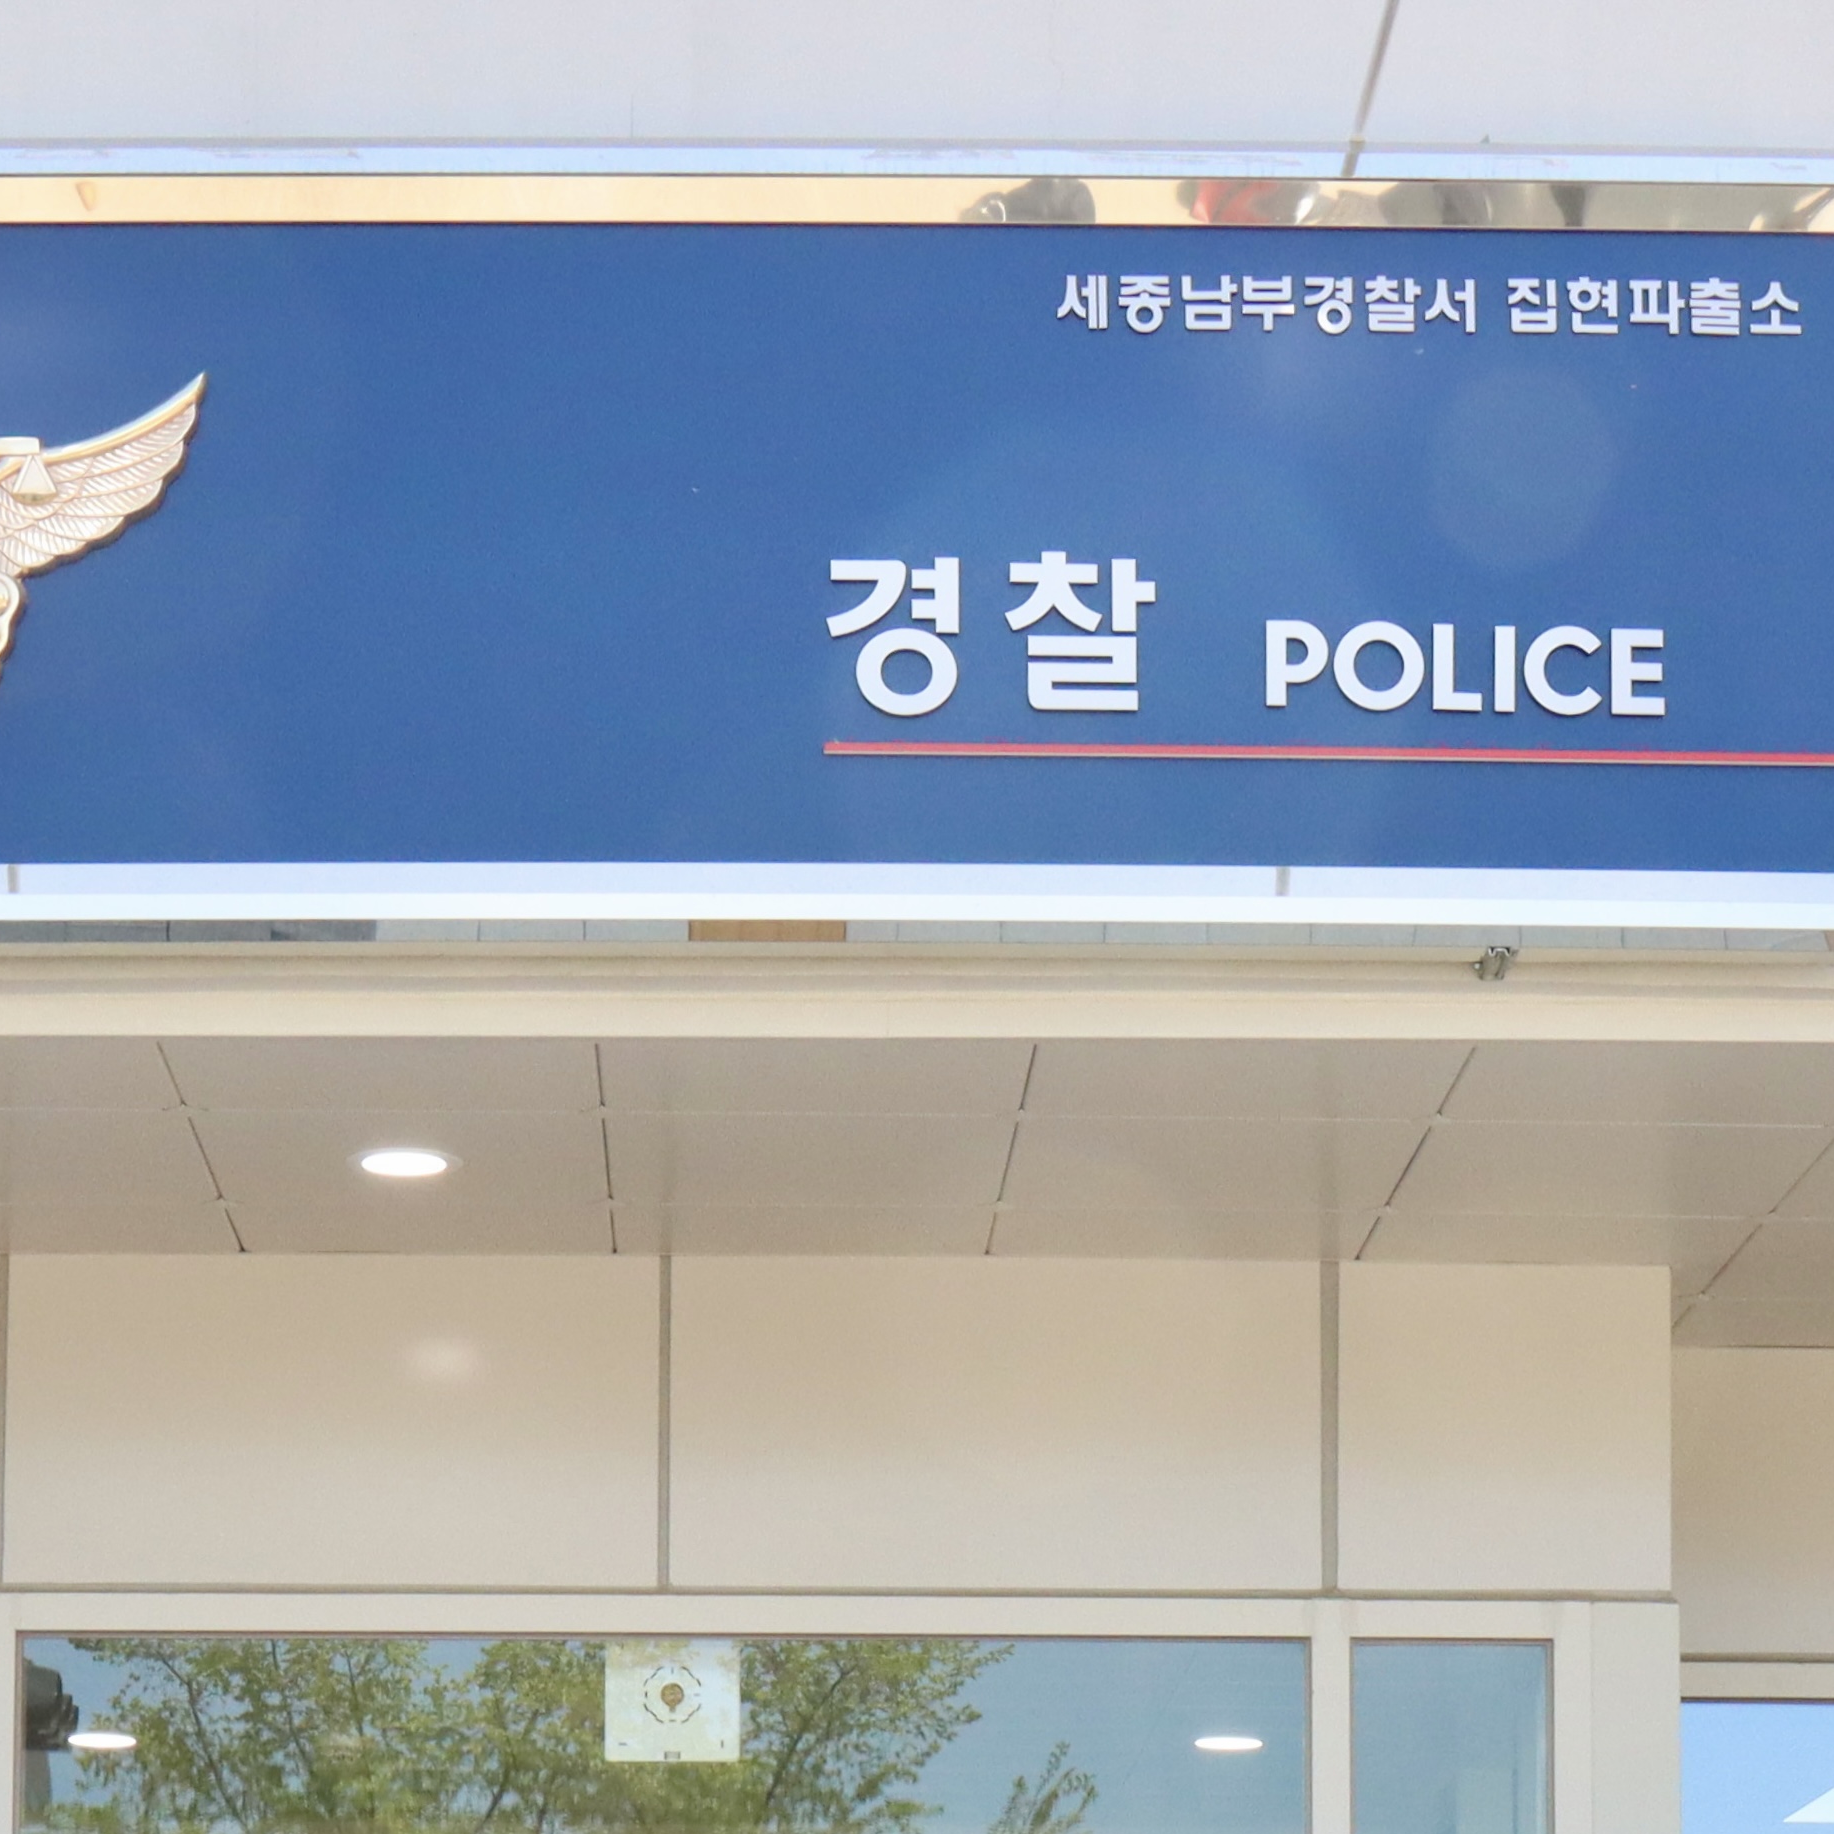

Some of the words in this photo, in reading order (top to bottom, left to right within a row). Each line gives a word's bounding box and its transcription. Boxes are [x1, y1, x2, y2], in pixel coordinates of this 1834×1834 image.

[1057, 274, 1476, 335] 세종남부경찰서
[1507, 277, 1803, 335] 집현파출소
[825, 550, 1156, 716] 경찰
[1264, 619, 1666, 717] POLICE
